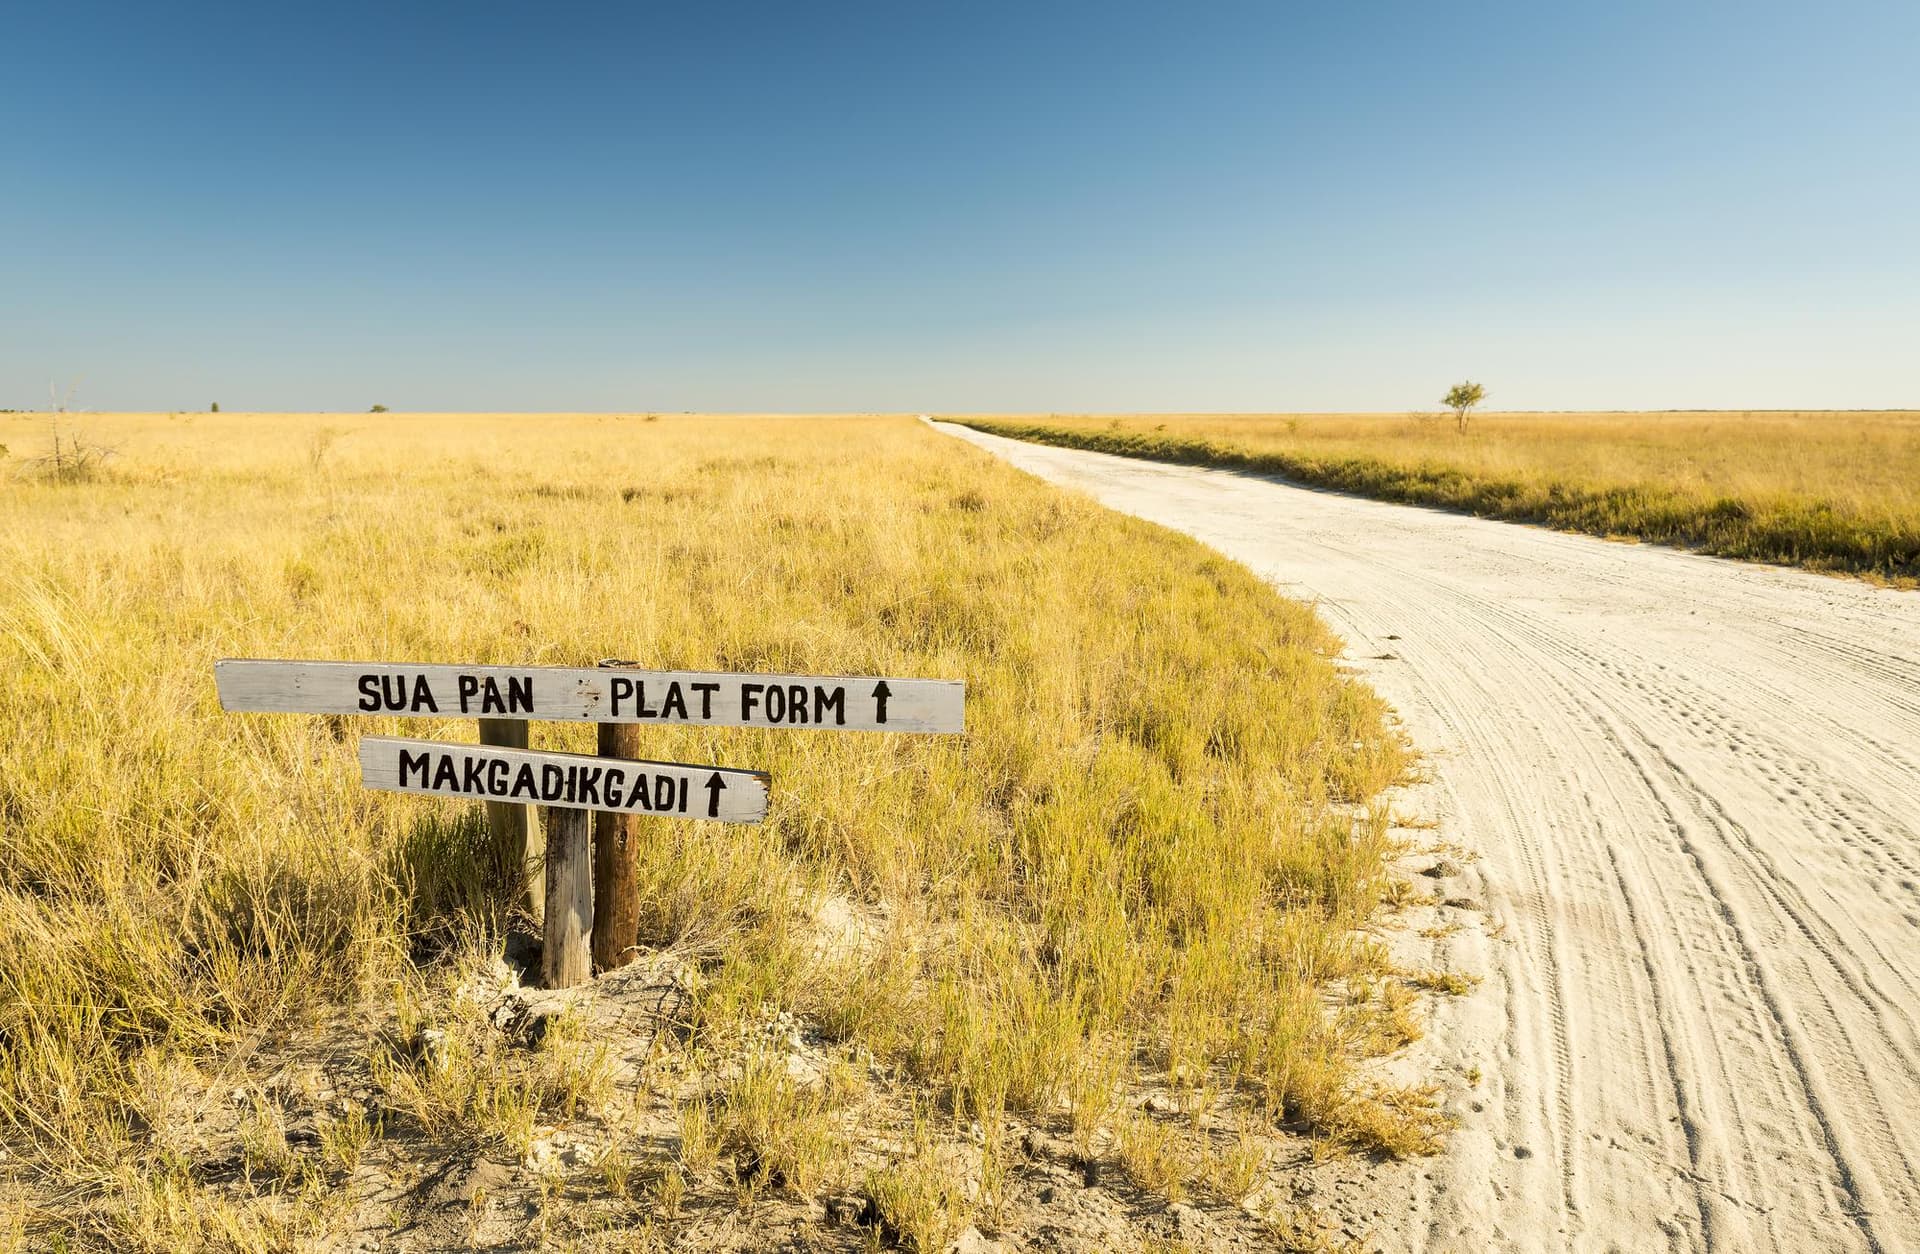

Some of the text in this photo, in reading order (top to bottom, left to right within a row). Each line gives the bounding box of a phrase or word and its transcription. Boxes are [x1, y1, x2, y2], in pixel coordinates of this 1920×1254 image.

[358, 674, 846, 726] SUA PAN PLAT FORM
[398, 749, 688, 813] MAKGADIKGADI
